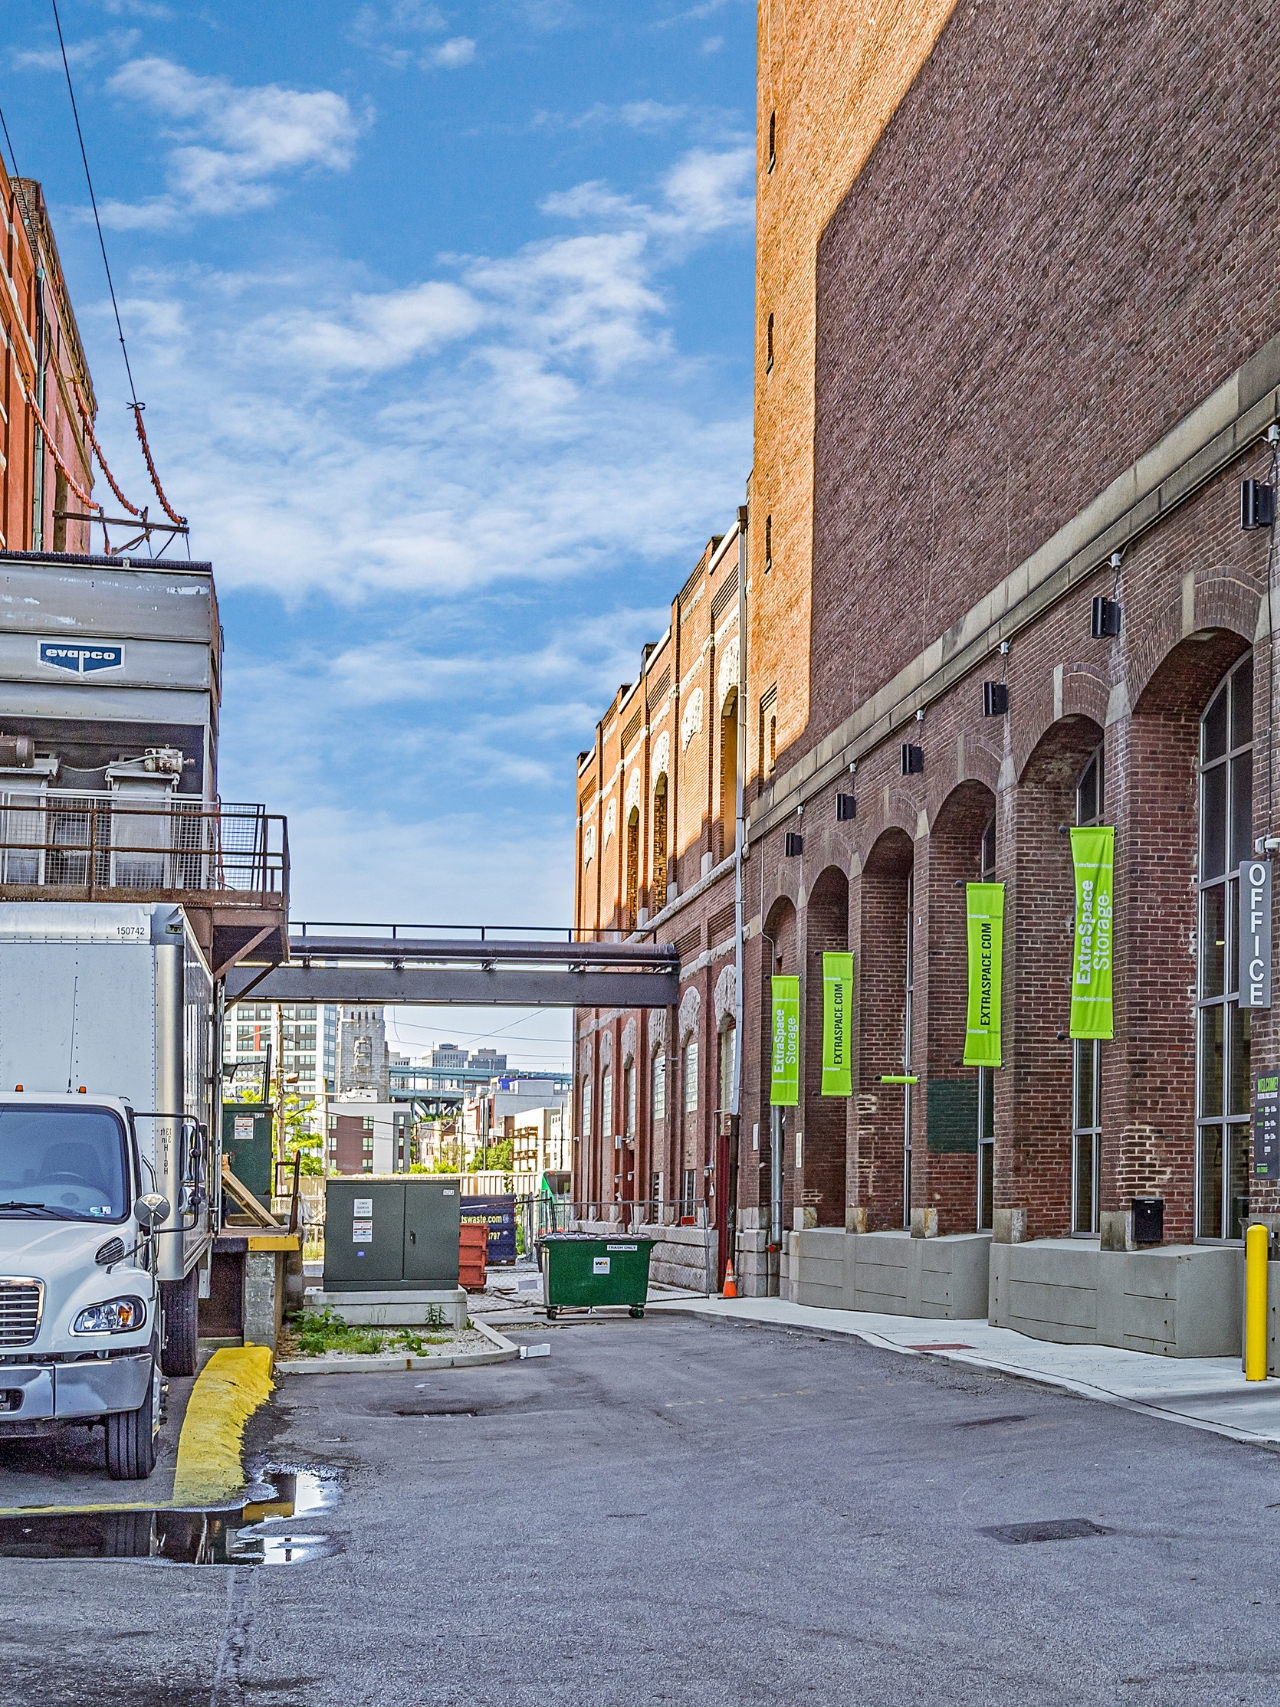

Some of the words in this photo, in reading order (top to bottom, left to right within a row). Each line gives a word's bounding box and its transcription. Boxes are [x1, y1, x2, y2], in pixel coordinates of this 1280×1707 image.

[45, 648, 116, 662] evapco
[116, 927, 145, 936] 150742
[1076, 879, 1095, 985] ExtraSpace
[1092, 894, 1113, 971] Storage
[1248, 863, 1266, 1006] OFFICE
[980, 922, 992, 1026] EXTRASPACE.COM
[773, 1009, 787, 1073] ExtraSpace
[785, 1018, 799, 1064] Storage
[833, 983, 843, 1065] EXTRASPACE.COM
